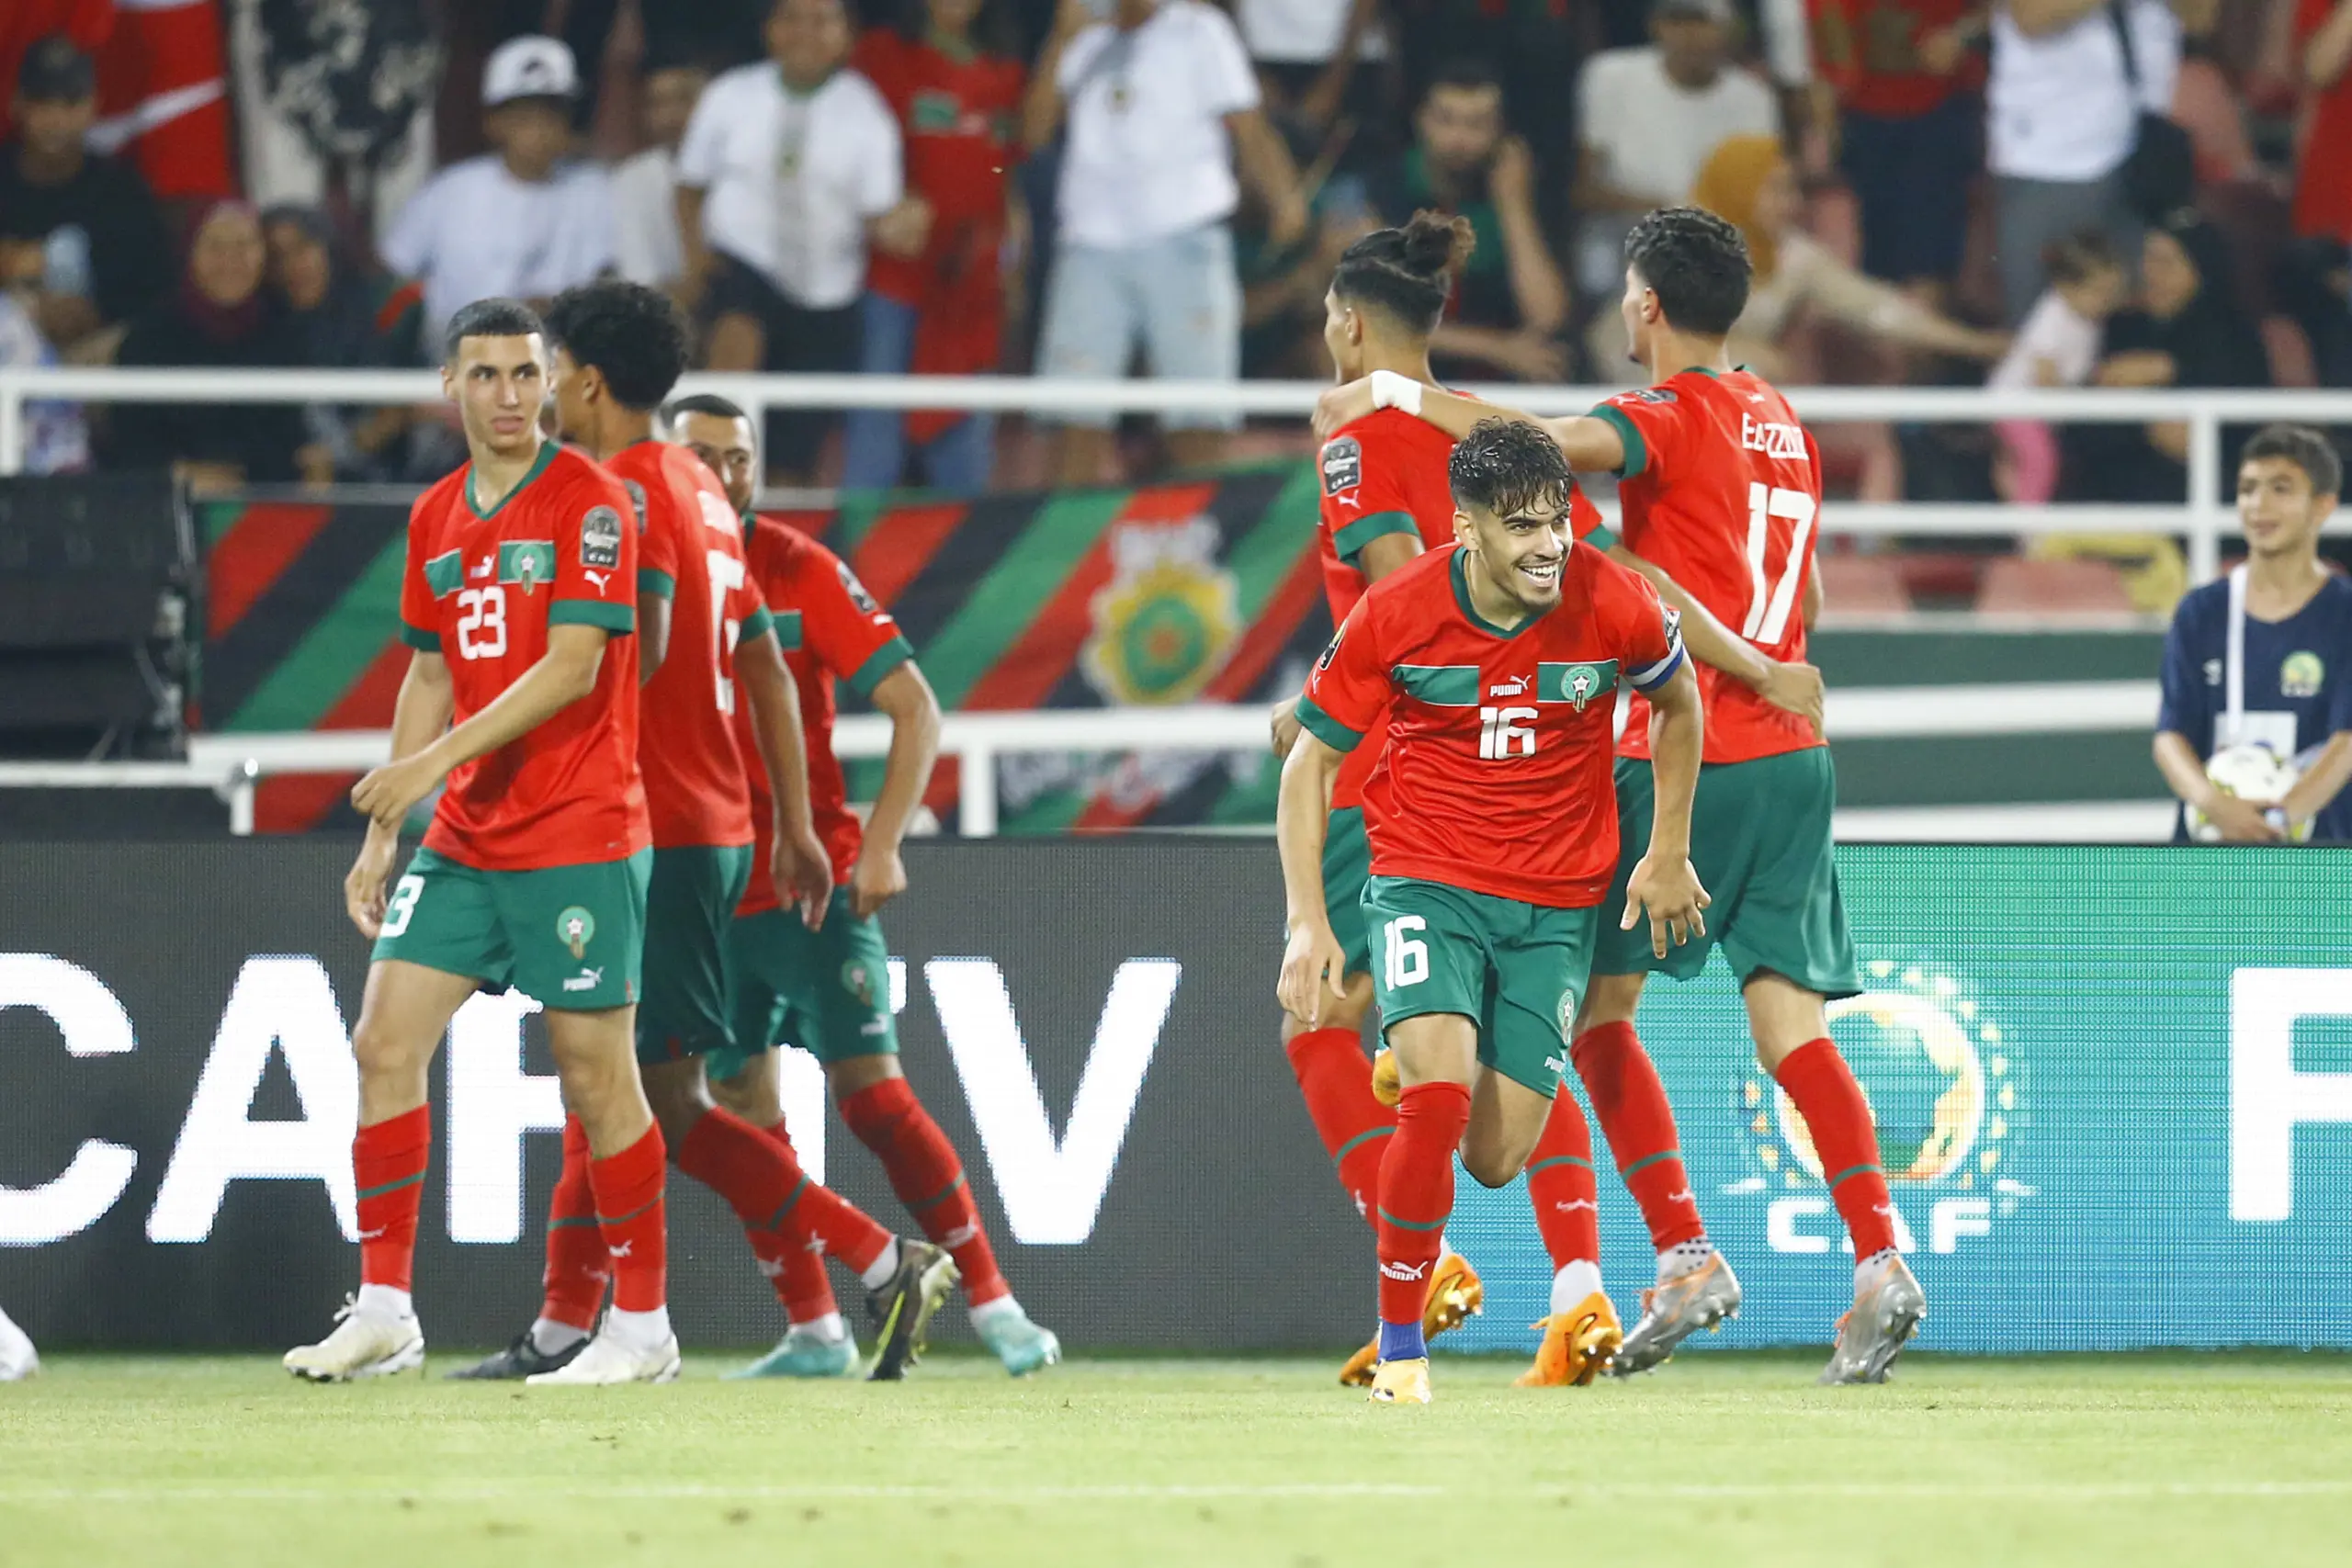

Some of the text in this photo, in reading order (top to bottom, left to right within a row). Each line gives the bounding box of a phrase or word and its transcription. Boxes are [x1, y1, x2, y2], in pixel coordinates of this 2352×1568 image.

[1742, 481, 1816, 645] 17
[458, 586, 506, 660] 23
[1490, 684, 1522, 697] PUMA
[1479, 706, 1539, 760] 16
[1384, 915, 1430, 992] 16
